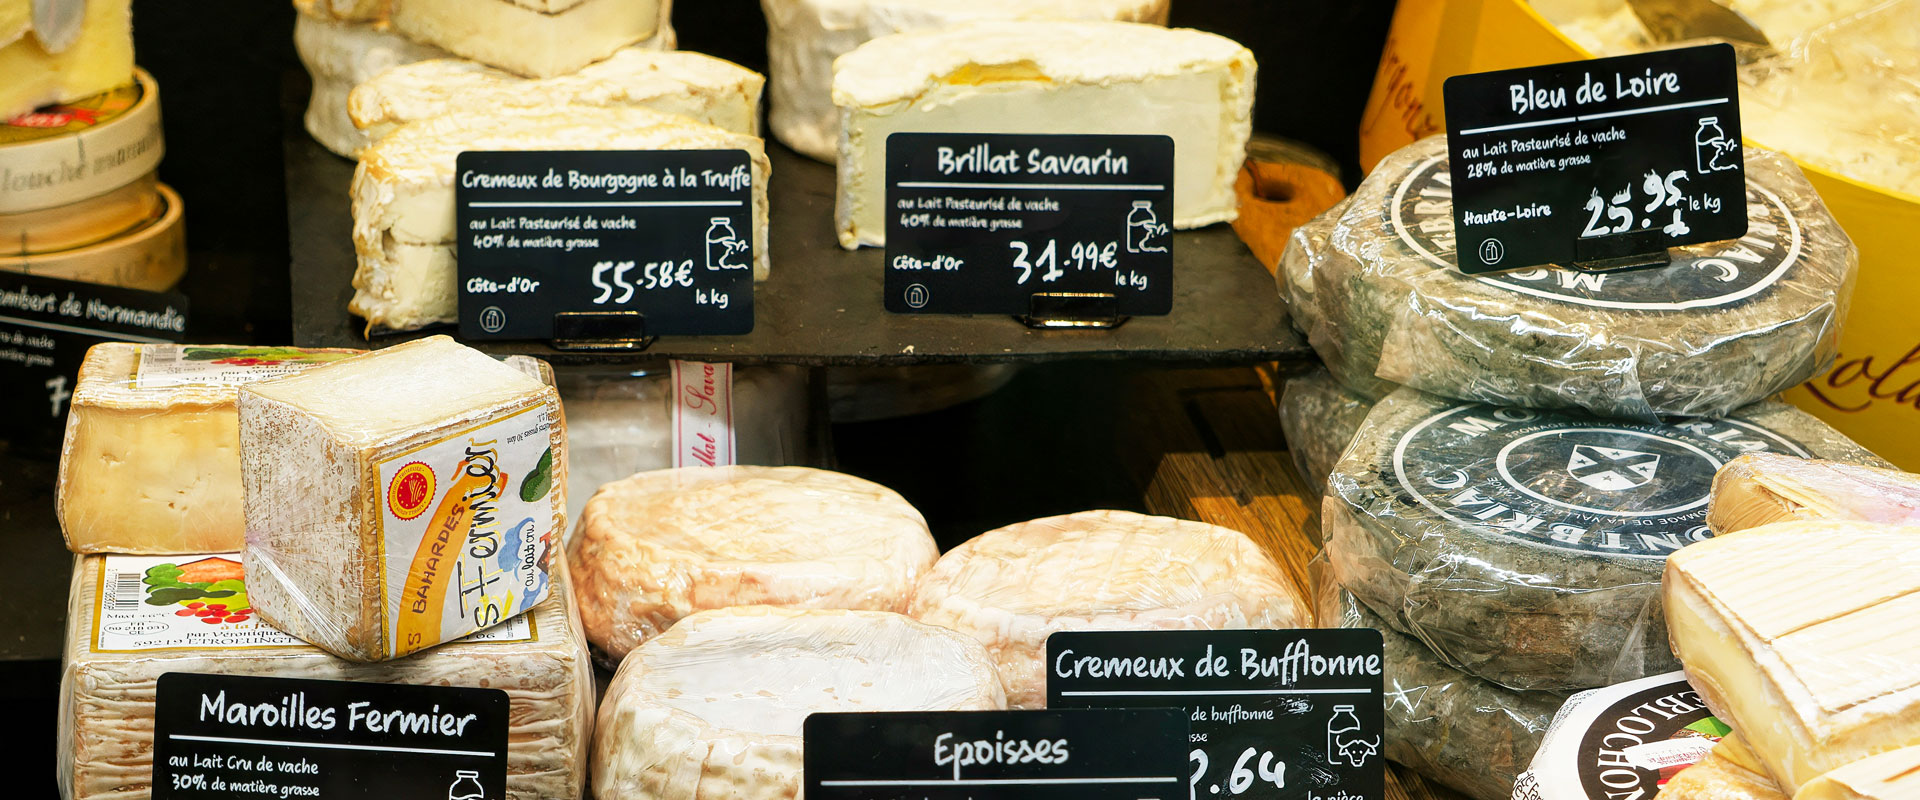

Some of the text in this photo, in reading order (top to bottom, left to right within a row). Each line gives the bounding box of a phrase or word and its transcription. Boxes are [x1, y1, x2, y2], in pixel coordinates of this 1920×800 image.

[1509, 68, 1680, 115] Bleu de Loire
[1463, 126, 1626, 159] au Lait Pasteurisé de vache
[938, 143, 1128, 175] Brillat Savarin
[1467, 154, 1591, 179] 28% de matière grasse
[462, 165, 751, 194] Cremeux de Bourgogne à la Truffe
[897, 197, 1059, 211] au Lait Pasteurisé de vache
[1463, 203, 1552, 226] Haute-Loire
[1689, 193, 1721, 213] le kg
[469, 215, 636, 230] au Lait Pasteurisé de vache
[900, 214, 1022, 232] 40% de matière grasse
[473, 235, 599, 252] 40% de matière grasse
[893, 255, 963, 271] Côte-d'Or
[1009, 238, 1118, 285] 31.99€
[467, 277, 540, 294] Côte-d'Or
[592, 259, 694, 304] 55.58€
[1115, 270, 1148, 290] le kg
[696, 288, 728, 308] le kg
[59, 292, 82, 317] de
[86, 299, 185, 332] Normandie
[1658, 508, 1710, 525] OMAGE
[412, 503, 465, 615] BAHARDES
[521, 543, 535, 573] lait
[1055, 638, 1382, 685] Cremeux de Bufflonne
[200, 690, 477, 737] Maroilles Fermier
[1191, 704, 1274, 725] de bufflonne
[169, 753, 319, 775] au Lait Cru de vache
[934, 730, 1069, 779] Epoisses
[172, 774, 320, 797] 30% de matière grasse
